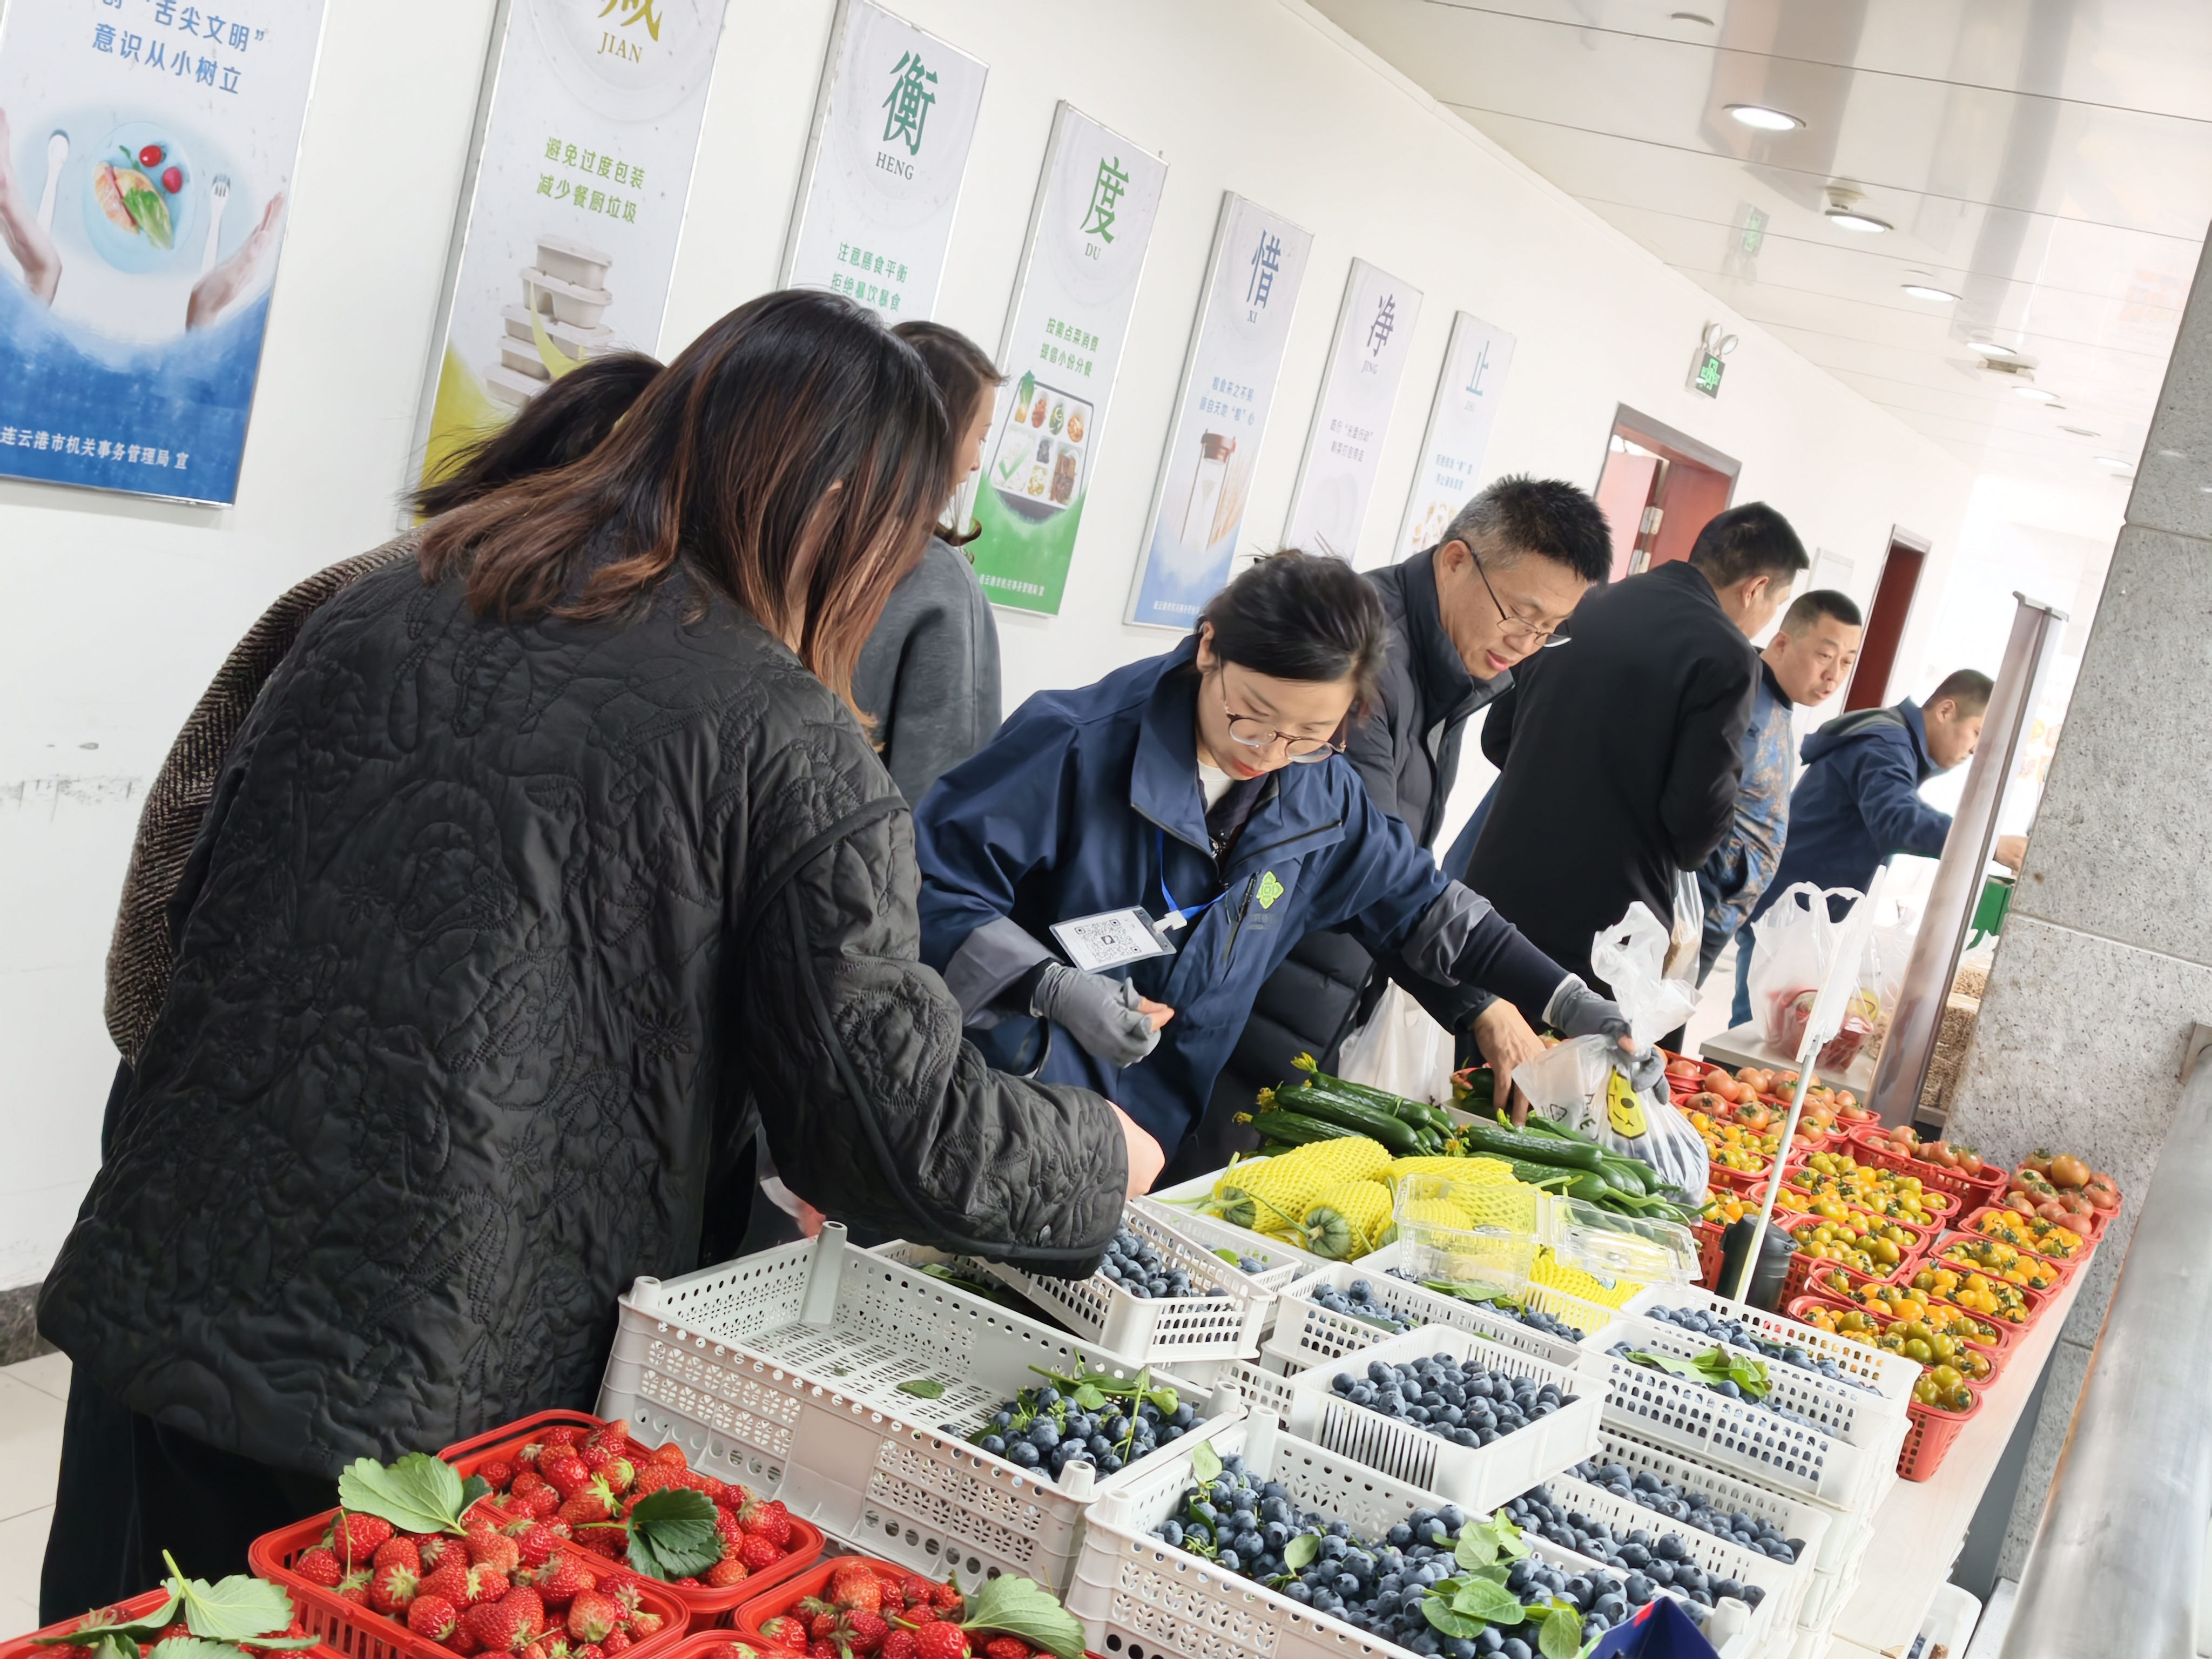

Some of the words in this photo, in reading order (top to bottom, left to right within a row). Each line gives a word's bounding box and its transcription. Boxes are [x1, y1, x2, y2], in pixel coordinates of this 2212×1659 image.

[103, 0, 264, 52] 舌尖文明”
[597, 31, 643, 64] JIAN
[92, 23, 241, 94] 意识从小树立
[882, 50, 938, 156] 衡
[544, 136, 645, 190] 避免过度包装
[875, 151, 914, 180] HENG
[537, 173, 637, 224] 减少餐厨垃圾
[1080, 156, 1129, 244] 度
[837, 241, 908, 284] 注意膳食平衡
[1085, 242, 1101, 260] DU
[1246, 230, 1281, 309] 惜
[830, 272, 901, 312] 拒绝暴饮暴食
[1246, 309, 1258, 324] XI
[1367, 294, 1395, 357] 净
[1466, 340, 1489, 397] 止
[0, 426, 170, 467] 连云港市机关事务管理局
